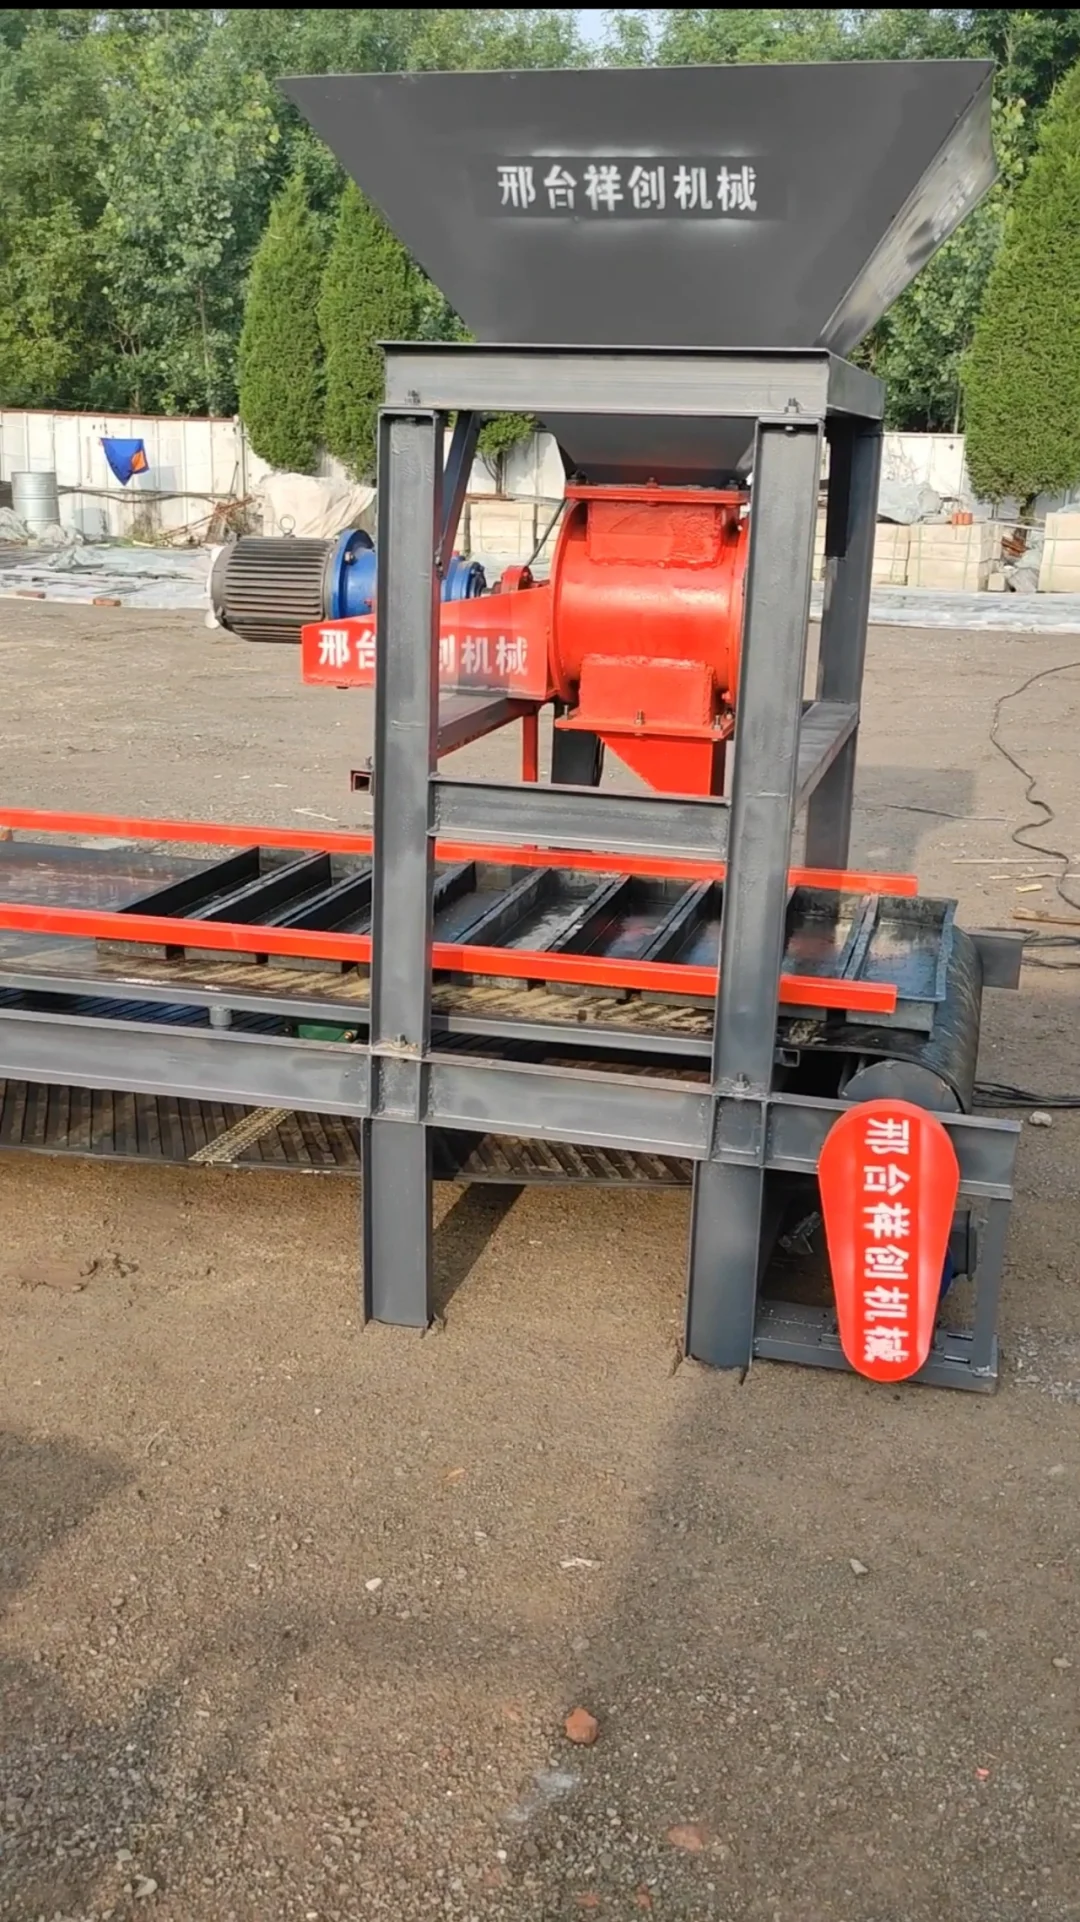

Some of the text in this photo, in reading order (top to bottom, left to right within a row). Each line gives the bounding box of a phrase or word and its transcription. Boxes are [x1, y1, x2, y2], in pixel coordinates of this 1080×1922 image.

[497, 164, 757, 211] 邢台祥创机械
[318, 628, 528, 676] 邢台机械
[863, 1117, 910, 1363] 邢台祥创机械
